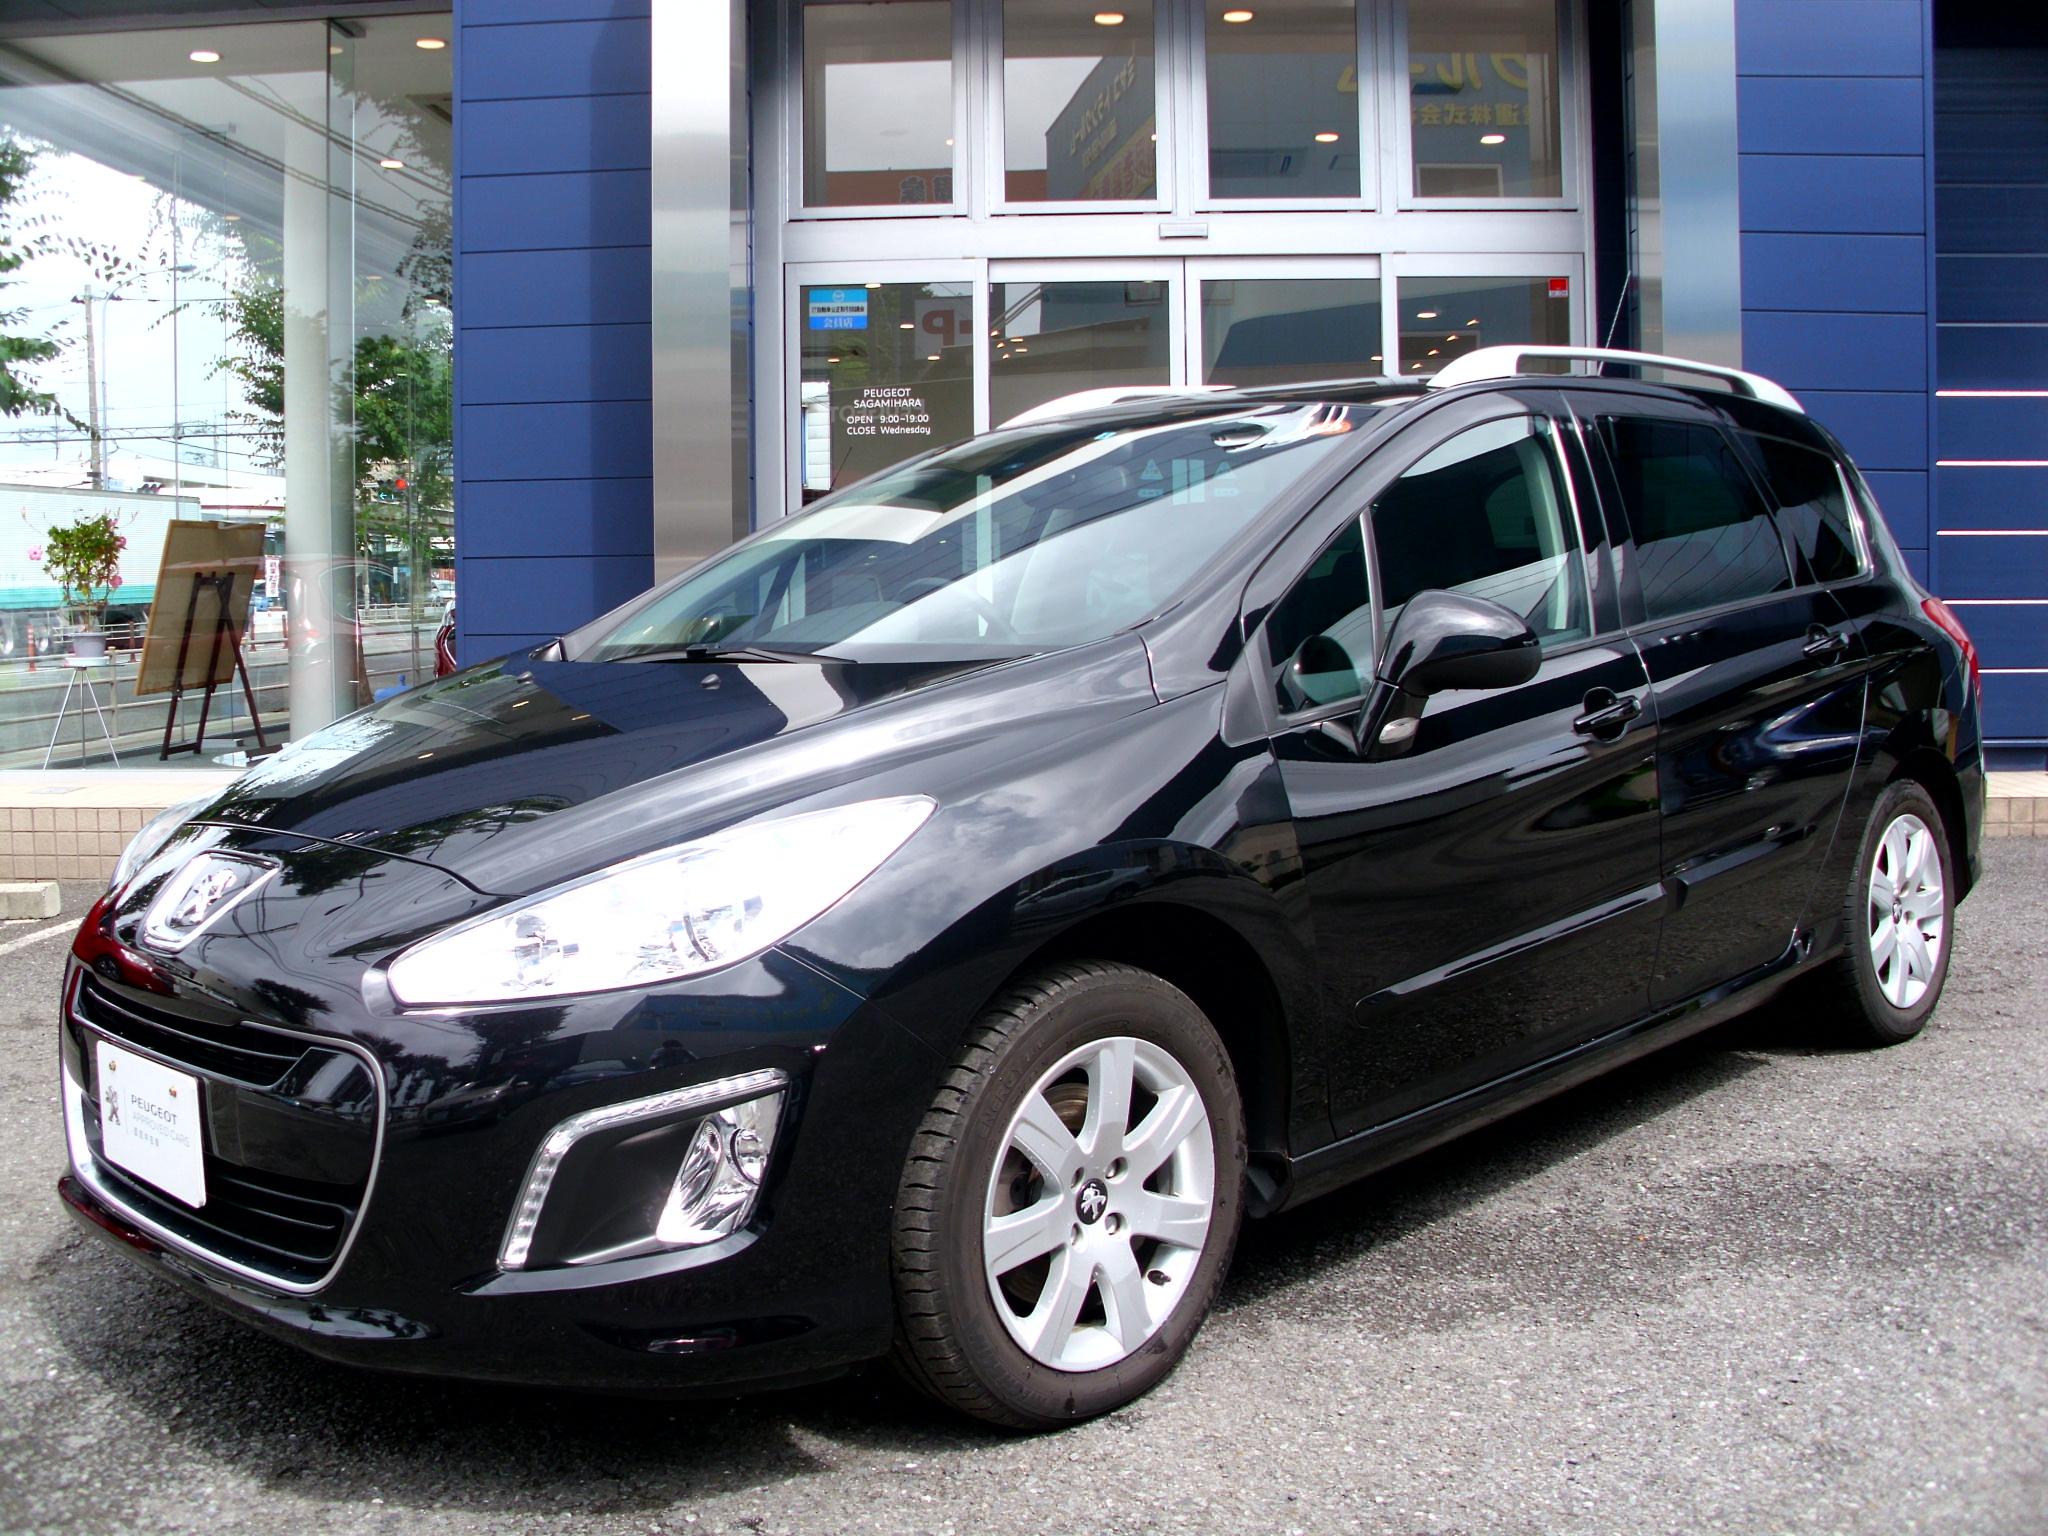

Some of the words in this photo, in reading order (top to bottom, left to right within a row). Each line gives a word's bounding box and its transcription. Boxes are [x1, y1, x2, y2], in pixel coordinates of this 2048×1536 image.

[823, 316, 854, 329] 会員店
[863, 387, 912, 399] PEUGEOT
[853, 398, 923, 410] SAGAMIHARA
[846, 415, 874, 424] OPEN
[846, 426, 877, 436] CLOSE
[880, 426, 931, 436] Wednesday
[131, 1094, 177, 1125] PEUGEOT
